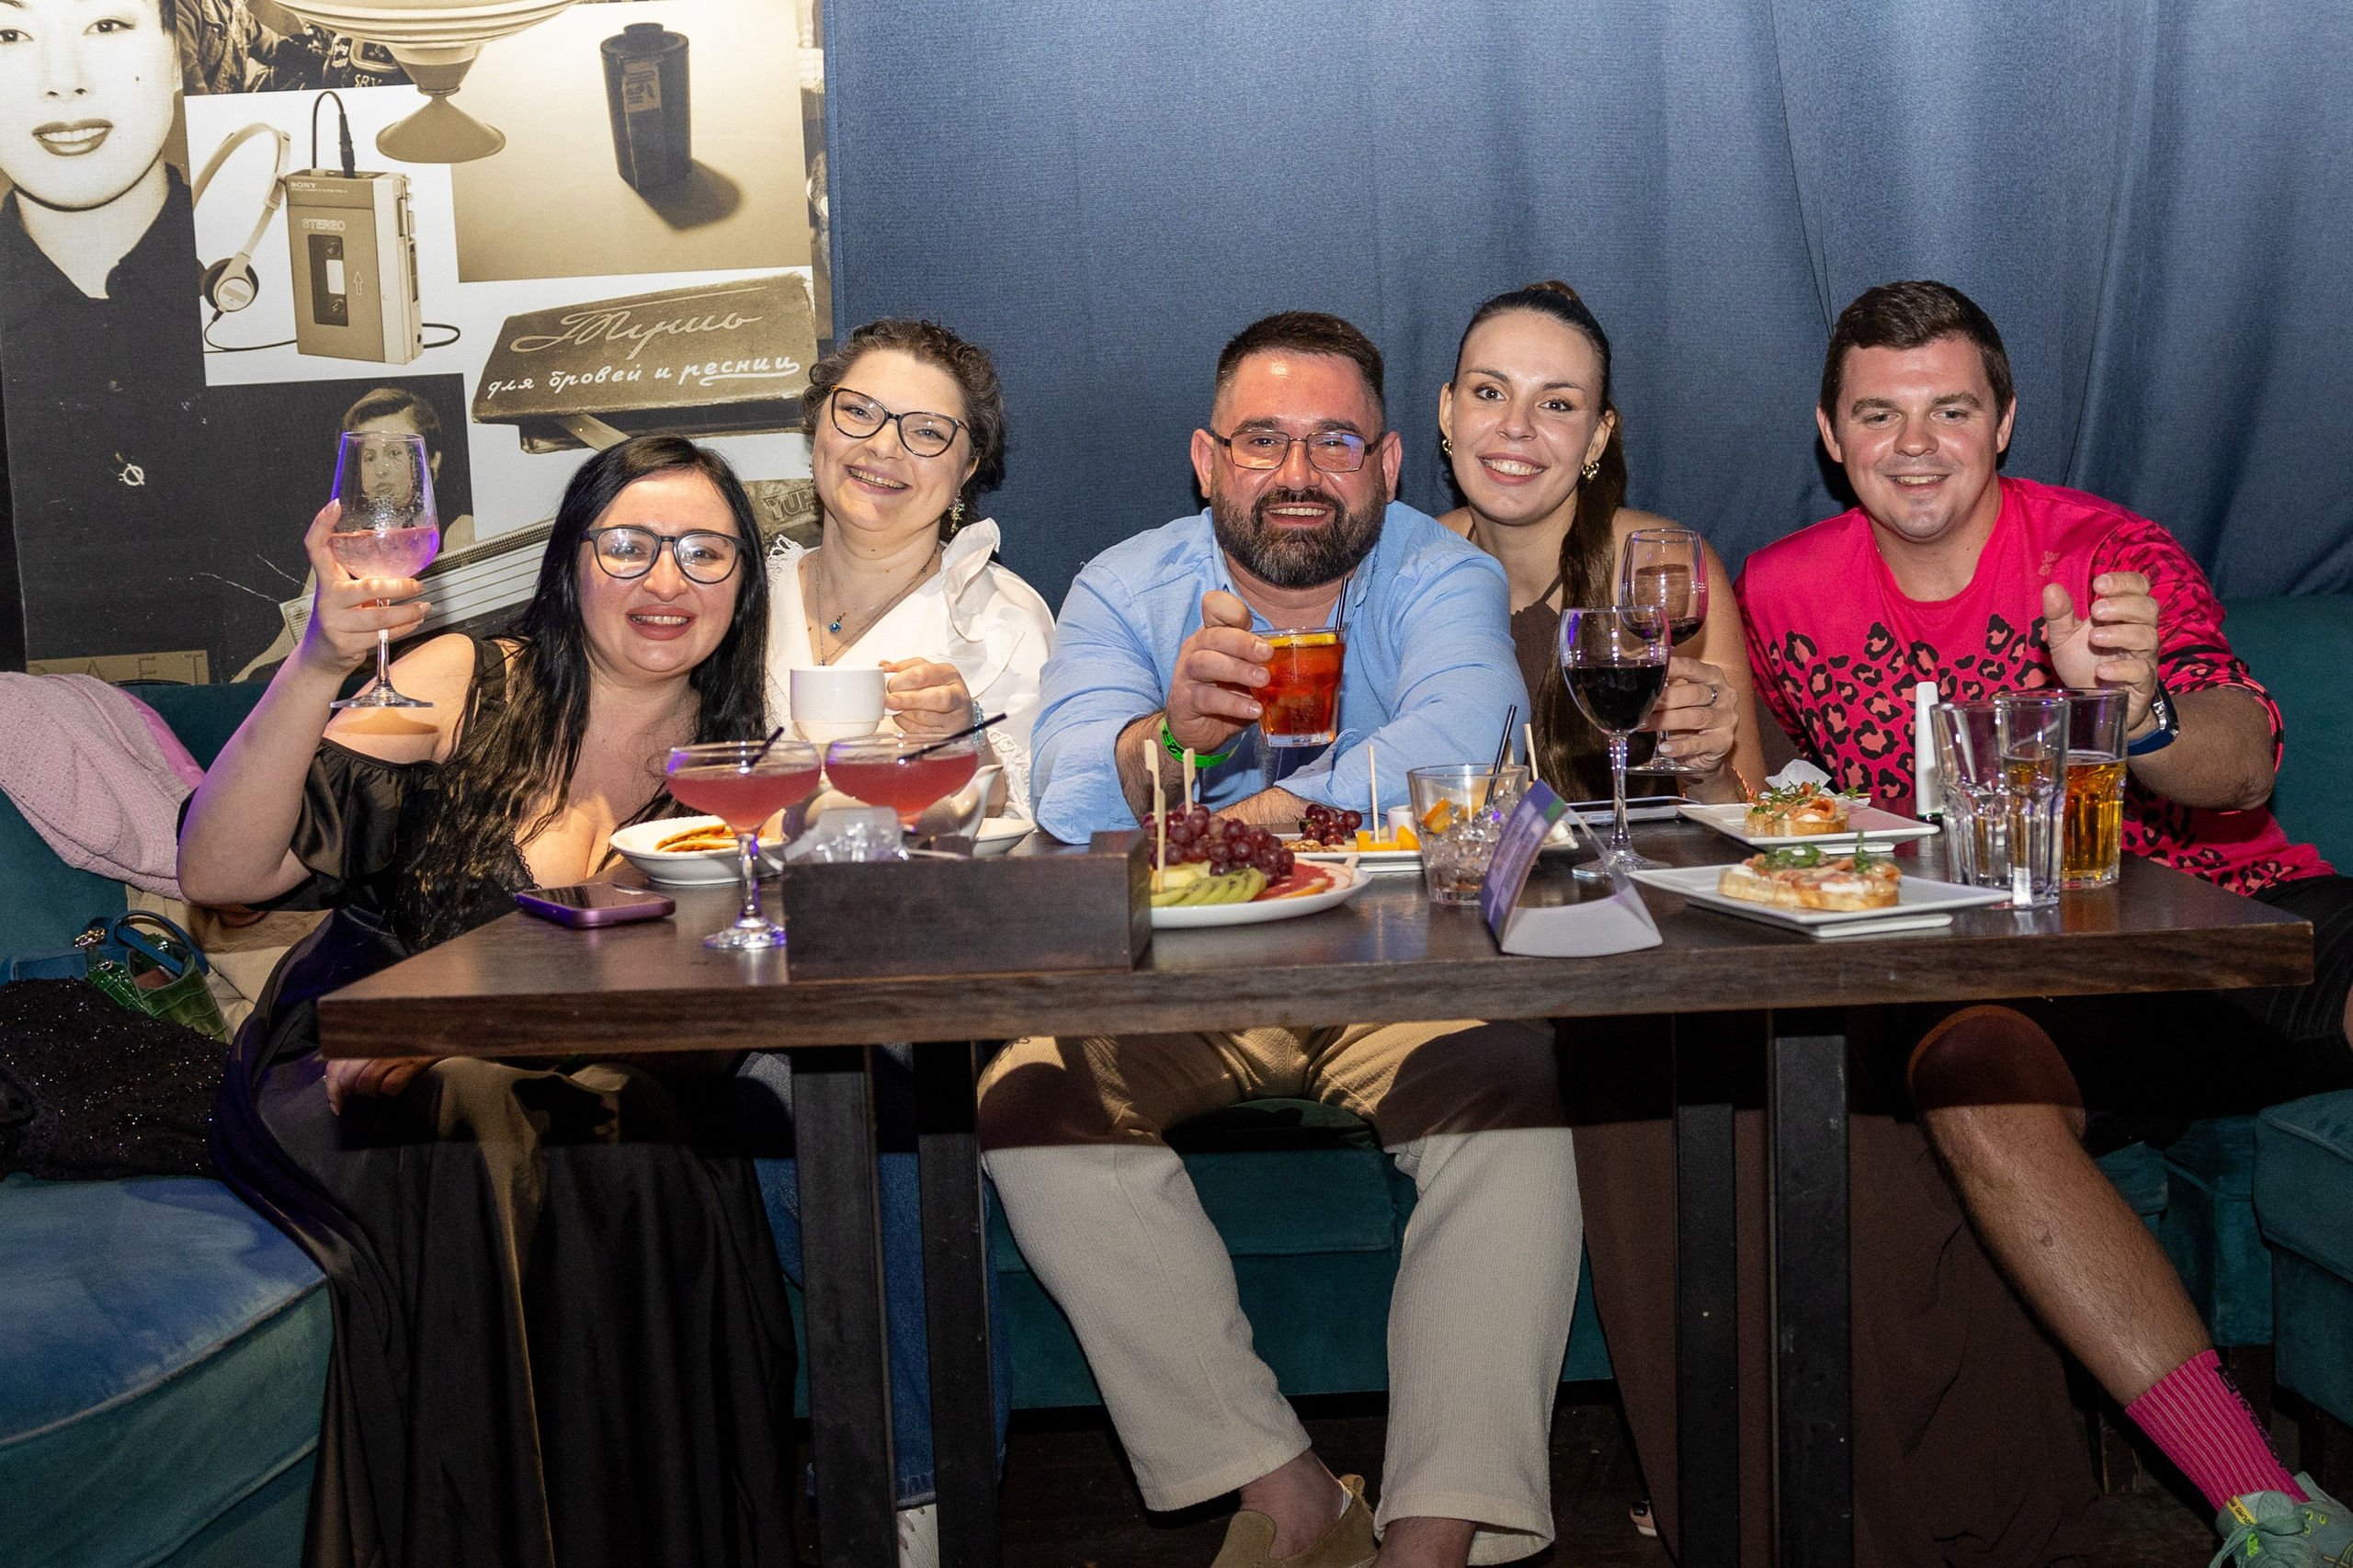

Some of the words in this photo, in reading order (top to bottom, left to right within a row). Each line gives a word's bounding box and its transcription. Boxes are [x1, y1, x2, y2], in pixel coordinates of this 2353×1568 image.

[301, 218, 347, 232] STEREO
[509, 287, 764, 360] Тушь
[487, 376, 535, 400] для
[548, 363, 642, 393] бровей
[654, 367, 672, 379] и
[677, 355, 801, 386] ресниц
